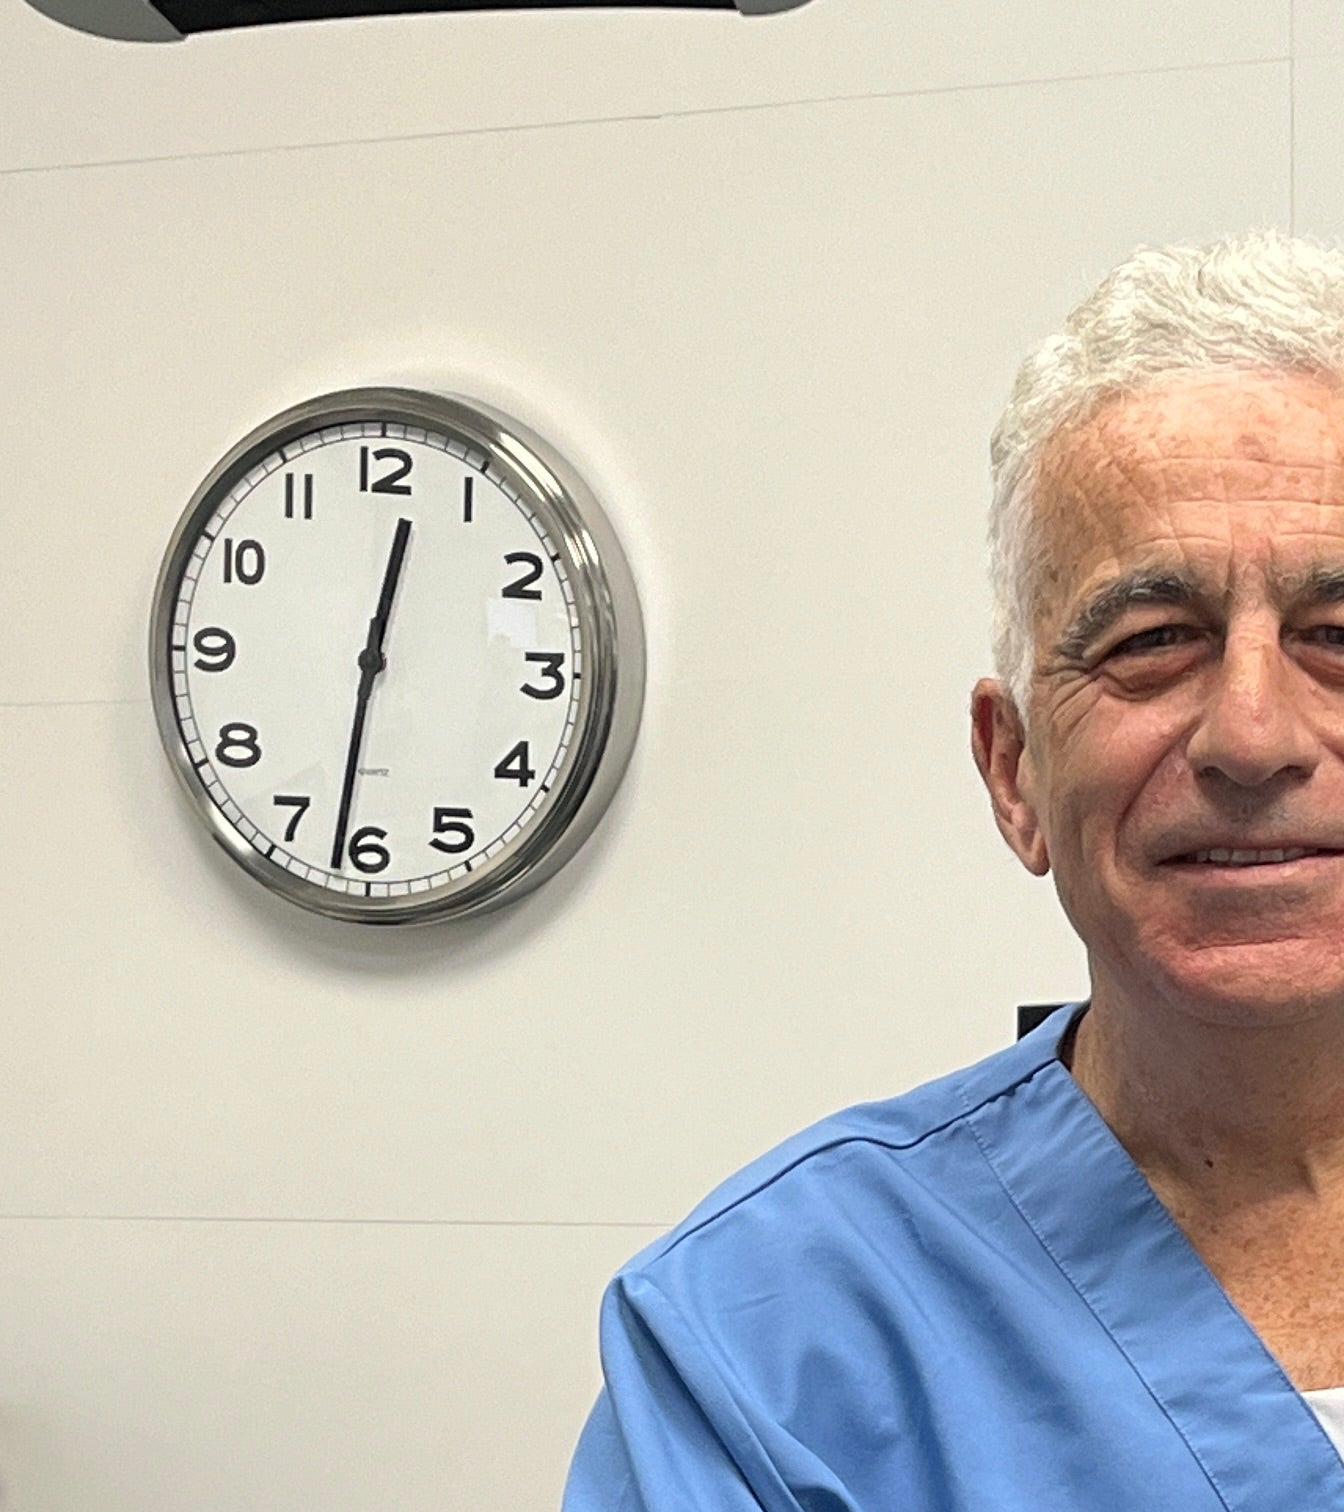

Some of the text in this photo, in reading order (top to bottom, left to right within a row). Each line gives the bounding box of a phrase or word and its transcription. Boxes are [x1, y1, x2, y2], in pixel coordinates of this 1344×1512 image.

[359, 446, 414, 495] 12
[285, 473, 313, 520] 11
[464, 477, 474, 522] 1
[224, 537, 266, 585] 10
[501, 552, 544, 600] 2
[192, 627, 236, 672] 9
[519, 651, 566, 700] 3
[215, 722, 262, 768] 8
[493, 740, 536, 788] 4
[273, 795, 311, 842] 7
[428, 806, 475, 854] 5
[348, 826, 391, 874] 6
